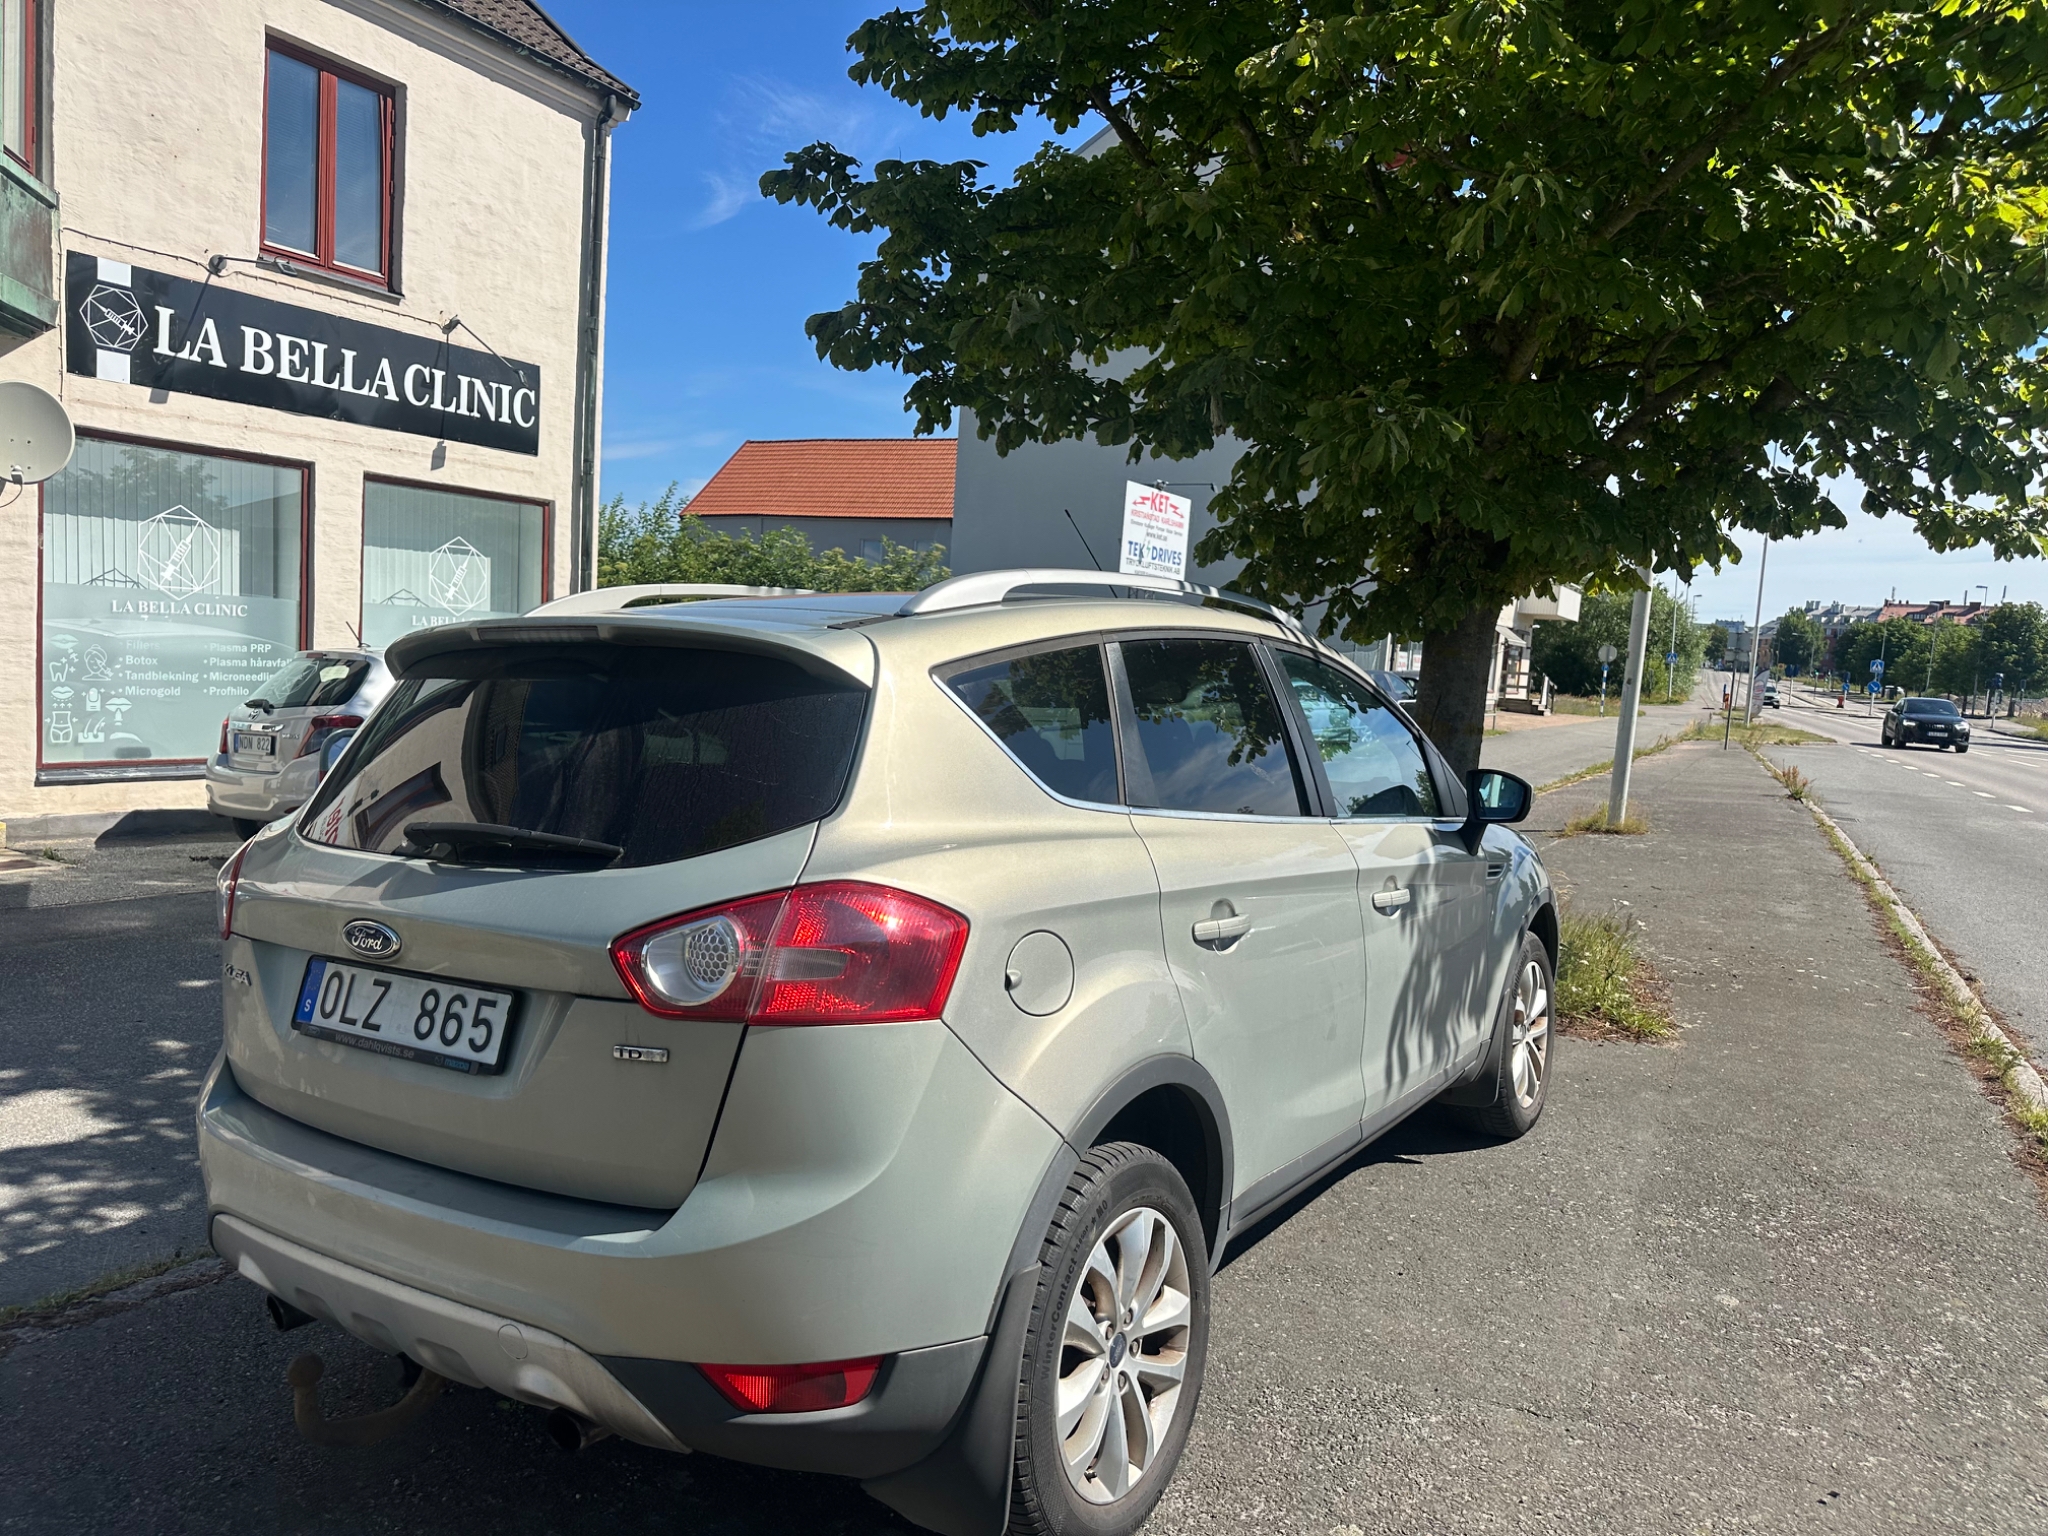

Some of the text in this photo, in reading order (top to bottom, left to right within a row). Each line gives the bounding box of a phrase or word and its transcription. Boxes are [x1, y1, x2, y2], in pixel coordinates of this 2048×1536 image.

[153, 305, 536, 428] LA BELLA CLINIC
[1150, 491, 1170, 514] KET
[1128, 540, 1182, 566] TEK DRIVES
[112, 600, 248, 617] LA BELLA CLINIC
[412, 614, 428, 626] LA
[126, 639, 160, 650] Fillers
[210, 642, 272, 653] Plasma PRP
[125, 654, 158, 666] Botox
[209, 657, 248, 667] Plasma
[125, 670, 199, 684] Tandblekning
[125, 685, 181, 698] Microgold
[209, 686, 250, 696] Profhilo
[240, 737, 270, 751] NDN 822
[351, 926, 384, 951] Ford
[304, 998, 312, 1013] S
[319, 969, 498, 1054] OLZ 865
[334, 1033, 415, 1060] www.dahlqvists.se
